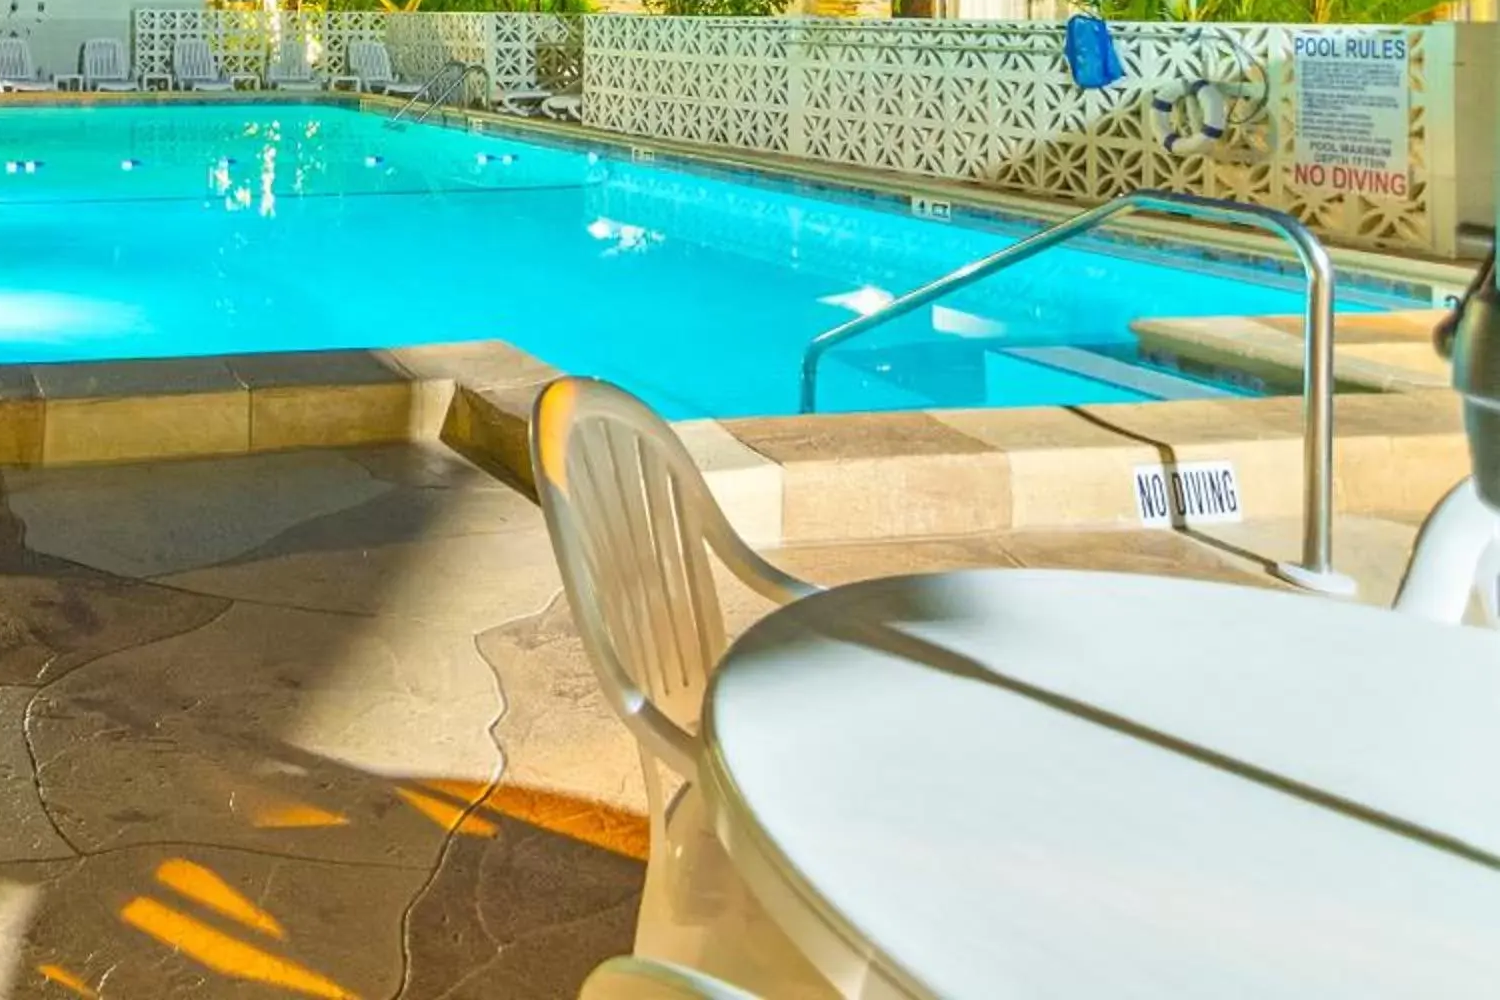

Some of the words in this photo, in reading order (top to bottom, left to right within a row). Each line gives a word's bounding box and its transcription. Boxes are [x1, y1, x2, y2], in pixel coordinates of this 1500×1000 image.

[1294, 36, 1341, 58] POOL
[1346, 38, 1406, 60] RULES
[1294, 163, 1326, 186] NO
[1333, 166, 1407, 197] DIVING
[1137, 473, 1166, 518] NO
[1171, 470, 1237, 516] DIVING
